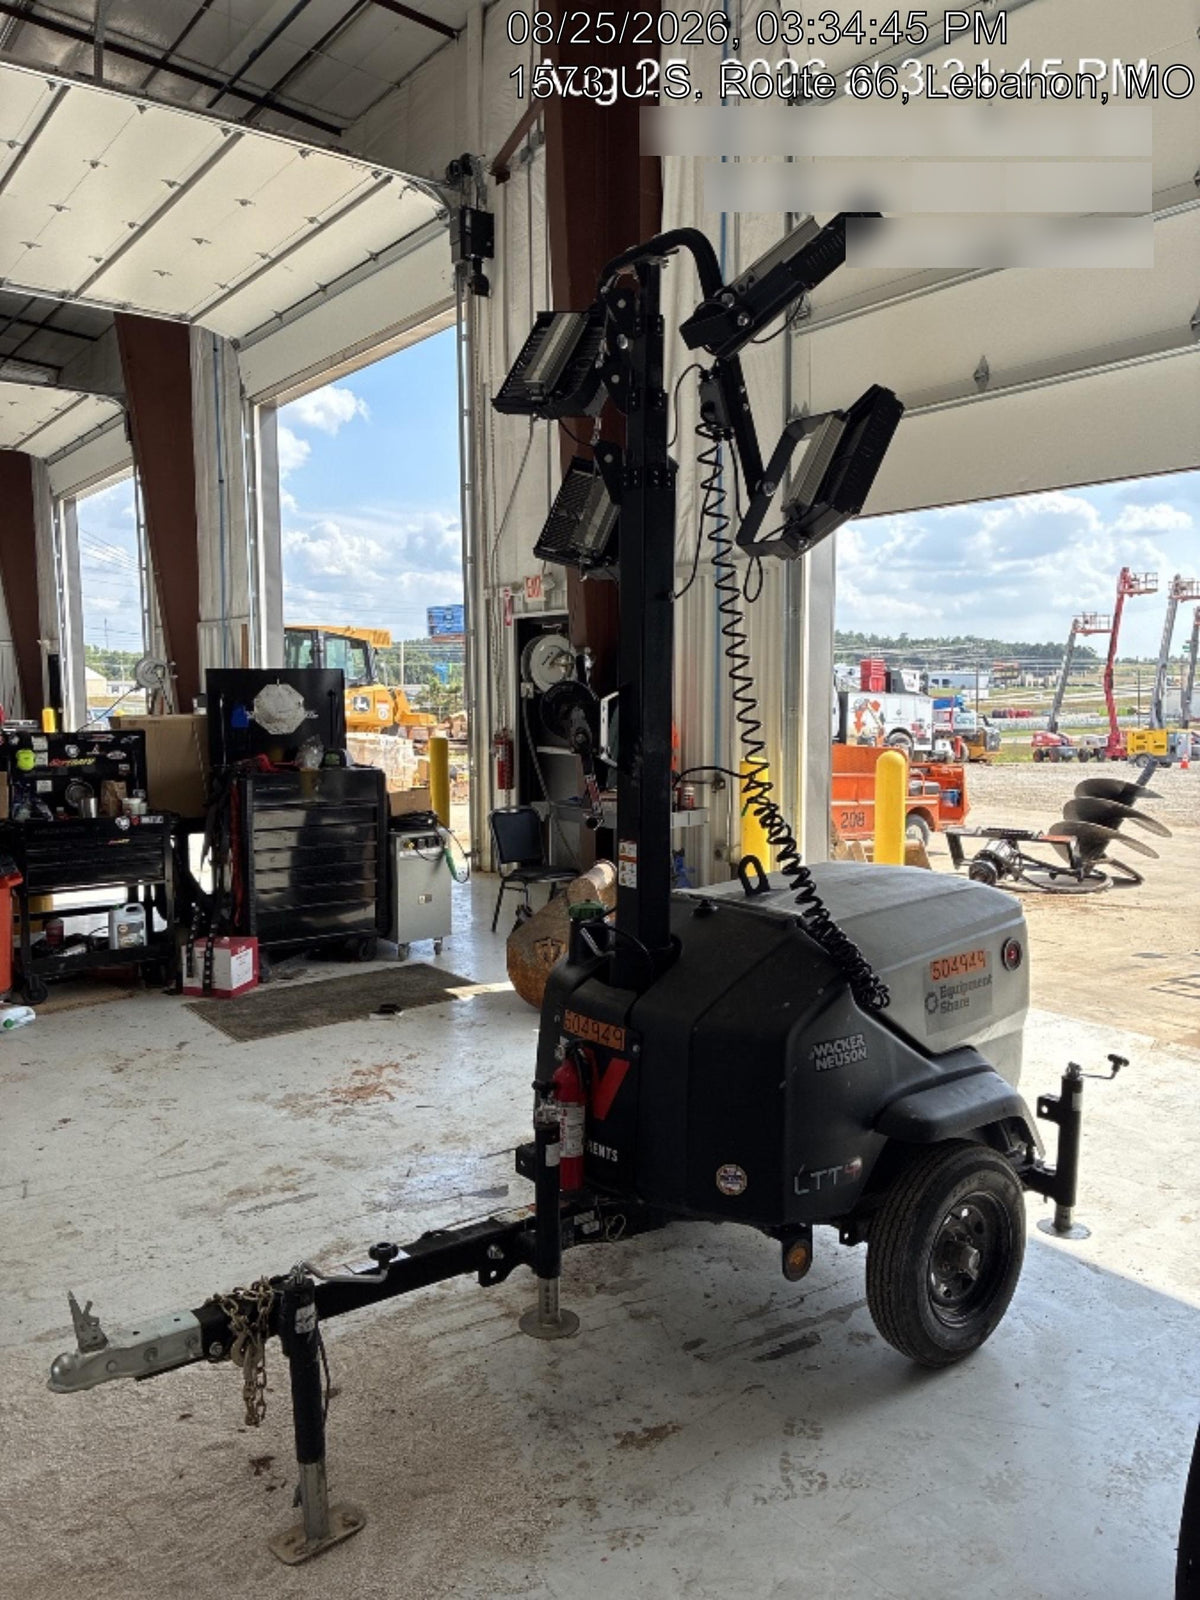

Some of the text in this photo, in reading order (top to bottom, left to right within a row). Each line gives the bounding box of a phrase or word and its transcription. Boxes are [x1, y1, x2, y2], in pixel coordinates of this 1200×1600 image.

[931, 949, 987, 981] 504949
[939, 973, 993, 999] Equipment
[940, 996, 970, 1014] Share
[563, 1009, 624, 1050] 504949
[812, 1033, 866, 1058] WACKER
[815, 1046, 868, 1071] NEUSON
